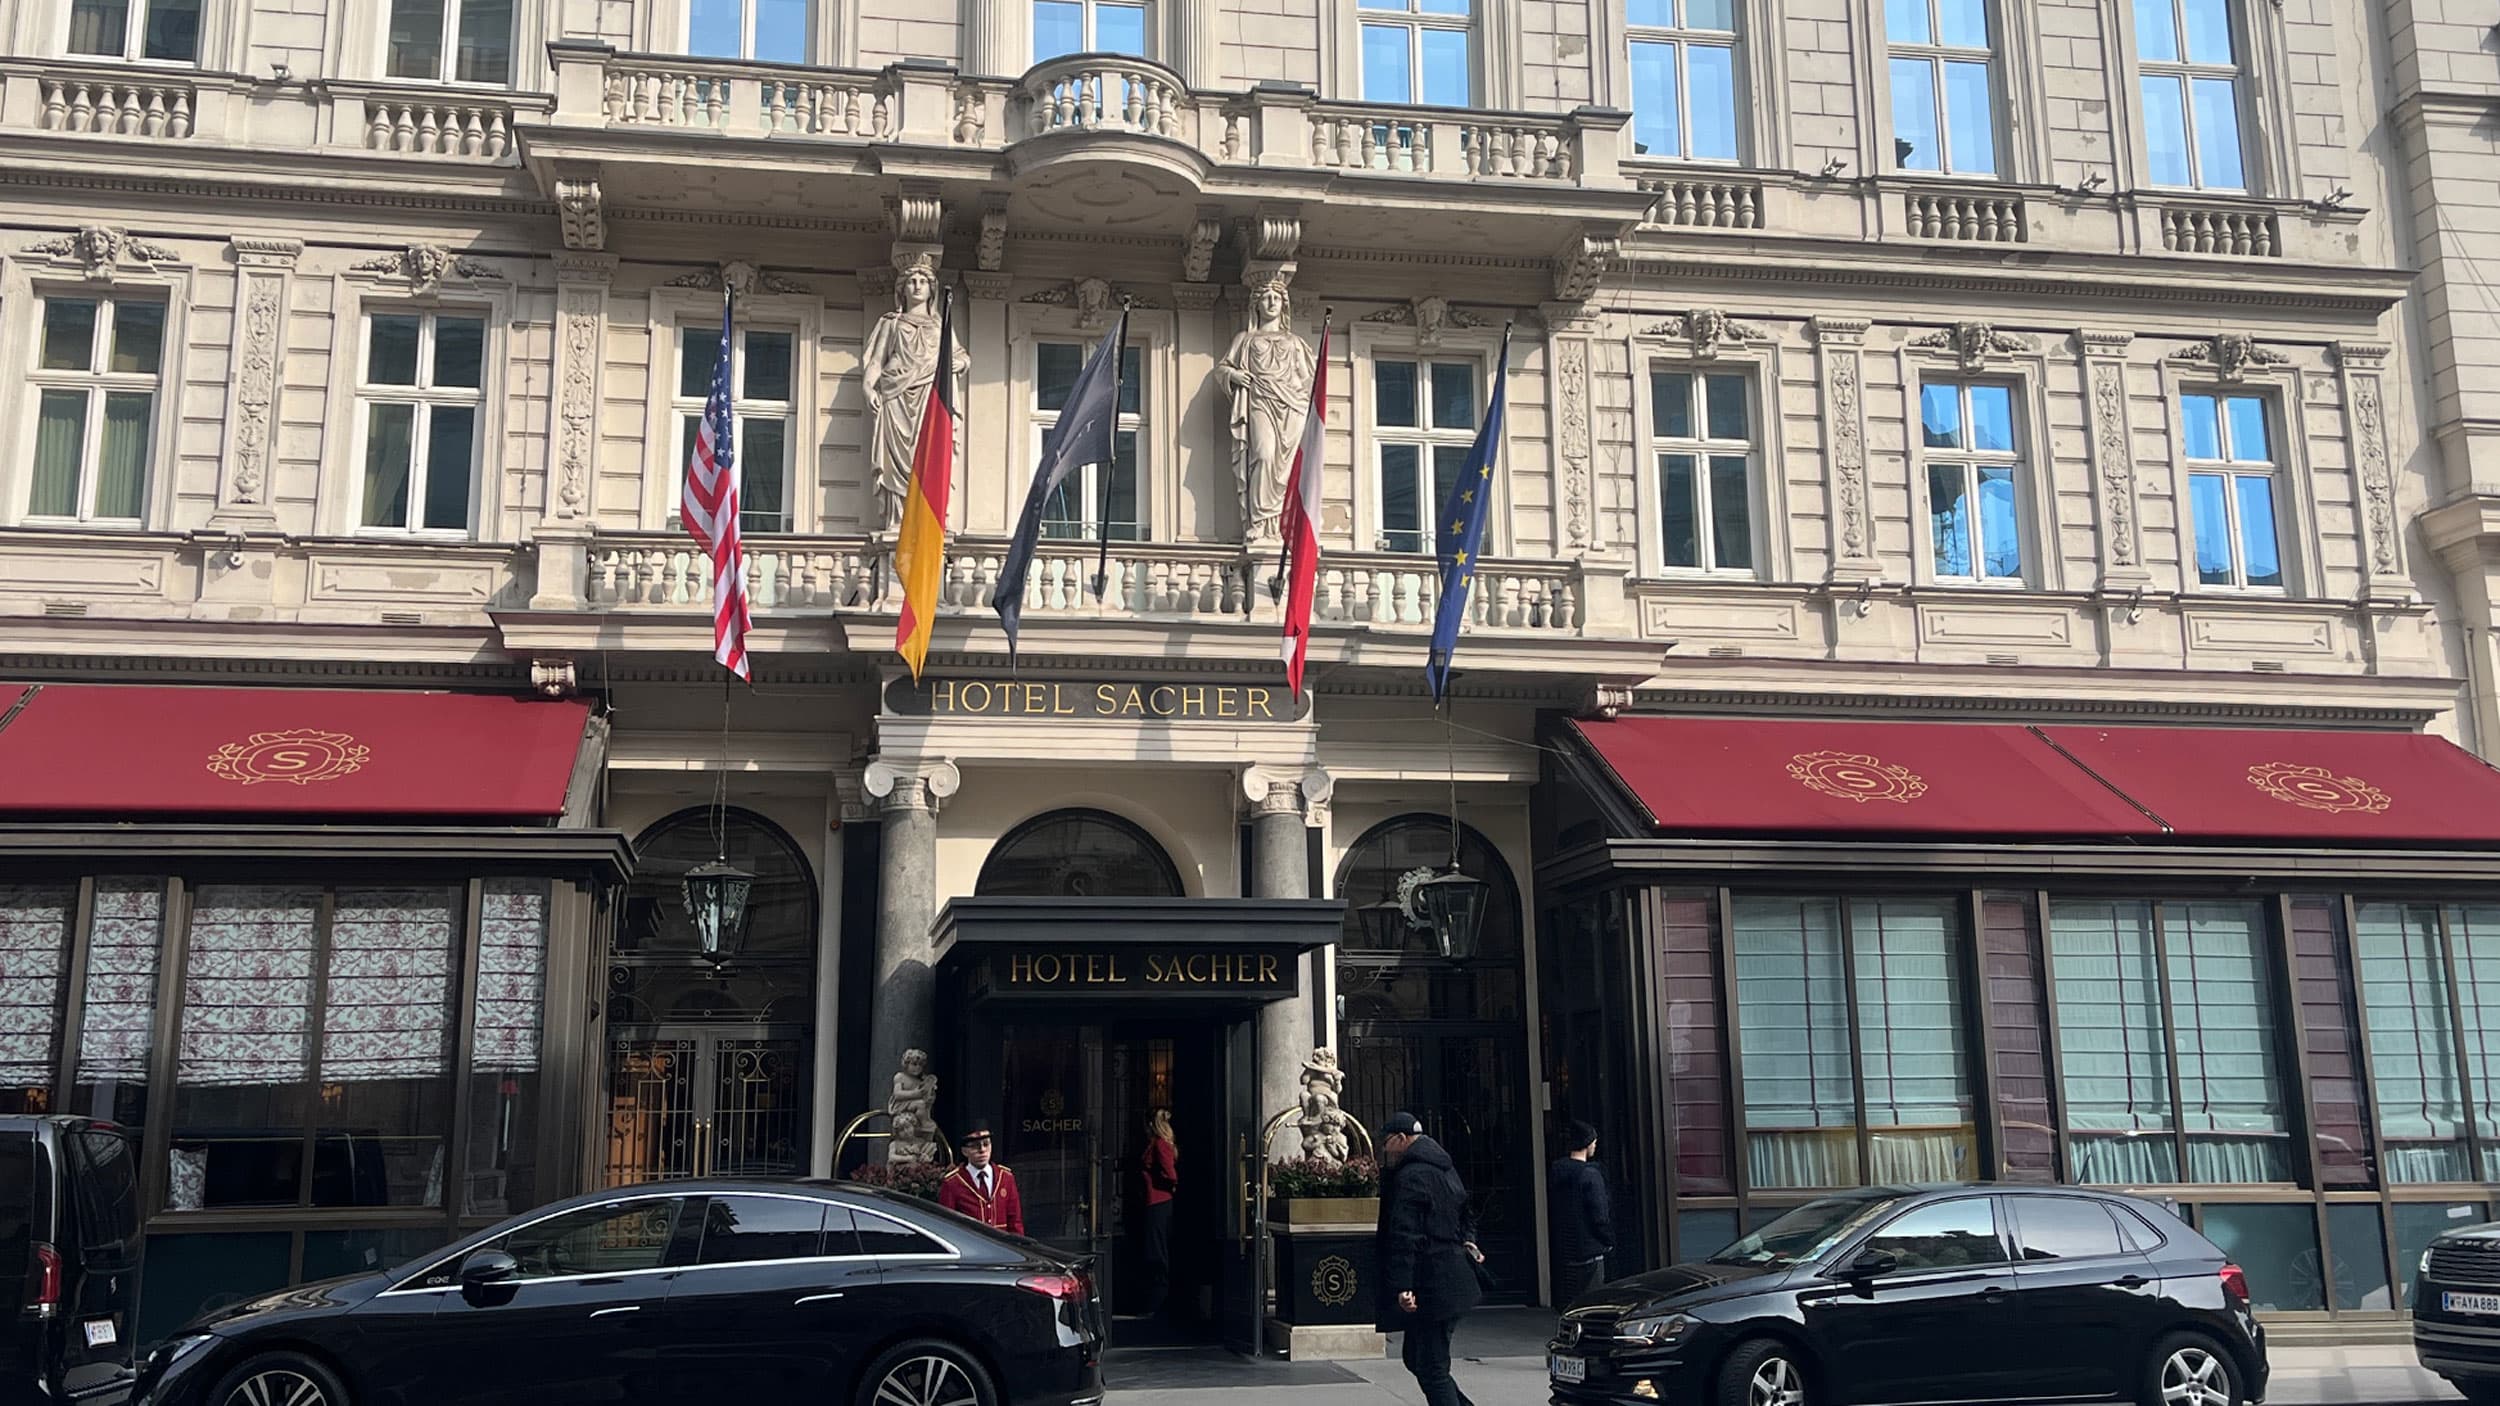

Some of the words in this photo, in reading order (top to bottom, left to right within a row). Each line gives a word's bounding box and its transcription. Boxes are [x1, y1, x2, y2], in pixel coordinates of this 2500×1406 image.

[931, 681, 1074, 713] HOTEL
[1096, 683, 1274, 717] SACHER
[267, 751, 309, 769] S
[1837, 771, 1876, 788] S
[2297, 783, 2340, 800] S
[1011, 954, 1126, 983] HOTEL
[1146, 955, 1278, 983] SACHER
[1023, 1119, 1082, 1132] SACHER
[1328, 1274, 1341, 1291] S
